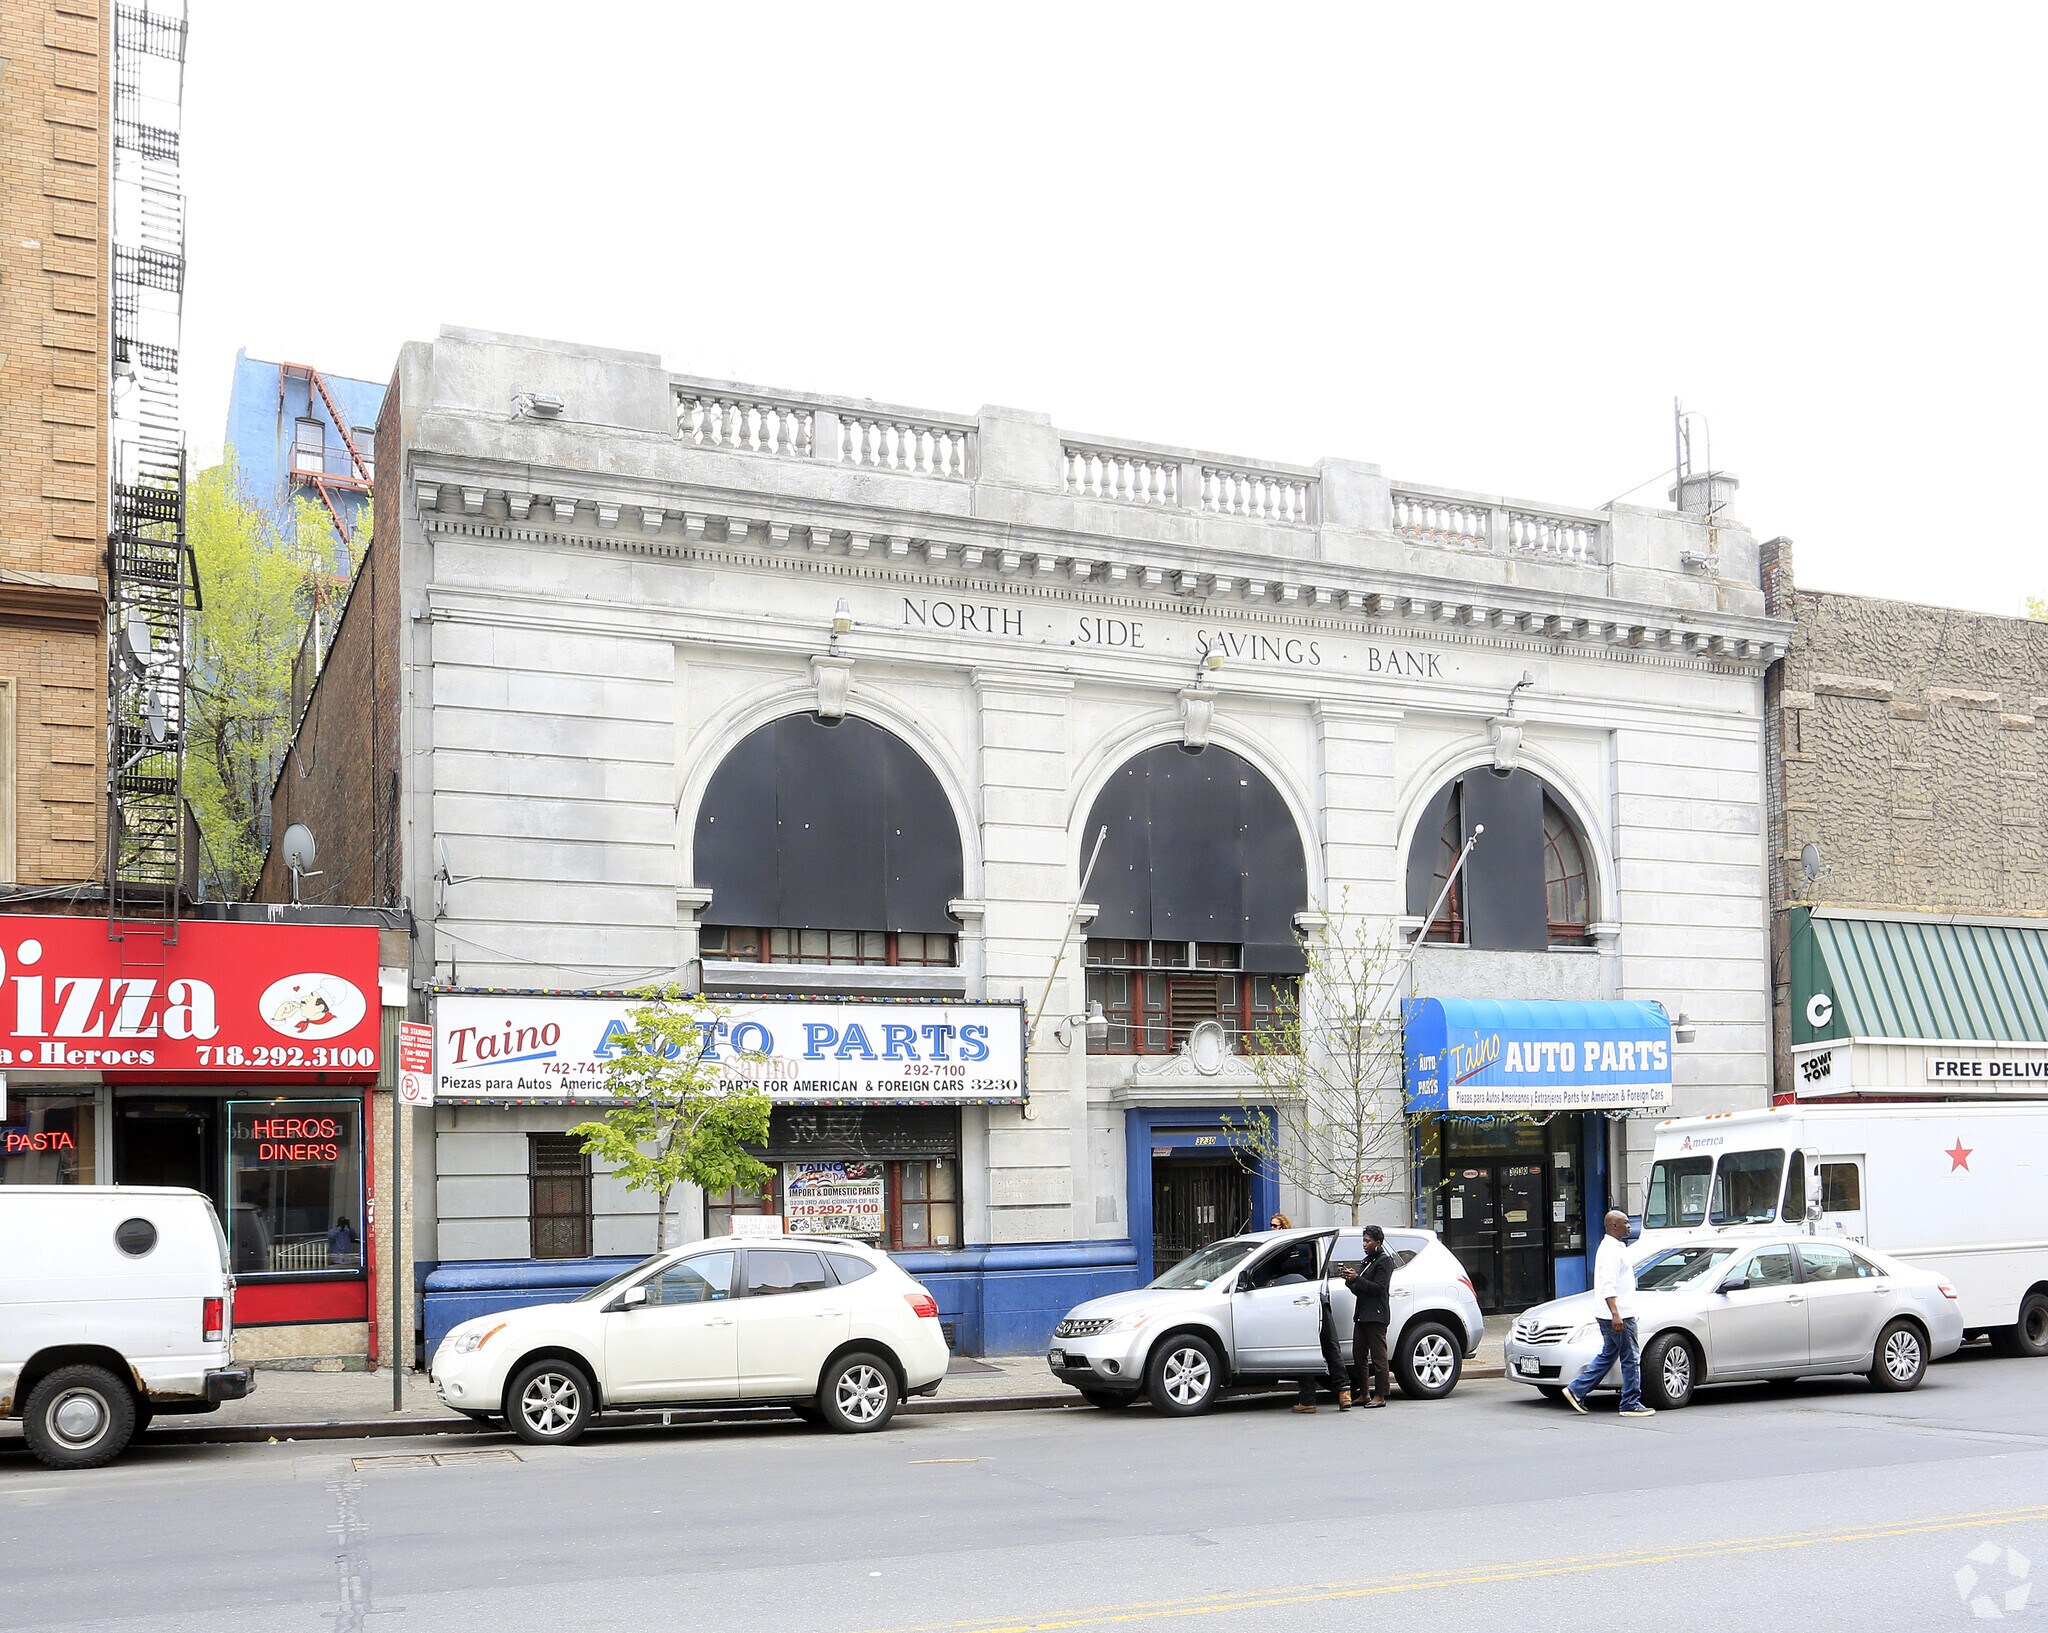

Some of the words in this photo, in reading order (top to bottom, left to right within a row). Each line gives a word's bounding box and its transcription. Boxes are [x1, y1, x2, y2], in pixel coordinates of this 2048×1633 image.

[902, 597, 1023, 636] NORTH
[1078, 616, 1145, 649] SIDE
[1195, 629, 1321, 666] SAVINGS
[1368, 647, 1444, 679] BANK
[0, 939, 219, 1041] izza
[1806, 993, 1833, 1028] C
[448, 1020, 561, 1064] Taino
[802, 1023, 990, 1061] PARTS
[38, 1041, 155, 1066] Heroes
[195, 1045, 375, 1067] 718.292.3100
[1450, 1030, 1500, 1078] Taino
[1504, 1041, 1575, 1073] AUTO
[1583, 1040, 1668, 1072] PARTS
[904, 1064, 966, 1077] 292-7100
[1419, 1056, 1436, 1071] AUTO
[1935, 1061, 1983, 1077] FREE
[441, 1076, 482, 1089] Piezas
[485, 1079, 514, 1092] para
[517, 1077, 552, 1090] Autos
[764, 1080, 788, 1092] FOR
[793, 1080, 858, 1092] AMERICAN
[865, 1080, 873, 1092] &
[878, 1081, 929, 1092] FOREIGN
[933, 1080, 964, 1091] CARS
[971, 1079, 1018, 1091] 3230
[1418, 1079, 1439, 1095] PARTS
[1456, 1091, 1473, 1104] Piezas
[1473, 1094, 1485, 1107] para
[1486, 1091, 1500, 1104] Autos
[1563, 1091, 1580, 1104] Parts
[1581, 1091, 1590, 1103] for
[1591, 1090, 1620, 1103] American
[1620, 1089, 1626, 1101] &
[1627, 1089, 1649, 1104] Foreign
[1650, 1088, 1664, 1101] Cars
[254, 1118, 336, 1139] HEROS
[7, 1131, 74, 1152] PASTA
[1197, 1137, 1216, 1145] 3230
[1680, 1136, 1724, 1151] America
[259, 1143, 338, 1161] DINER'S
[795, 1162, 844, 1172] TAINO
[789, 1188, 815, 1197] IMPORT
[816, 1188, 822, 1196] &
[823, 1187, 858, 1197] DOMESTIC
[858, 1187, 880, 1196] PARTS
[790, 1204, 879, 1216] 718-292-7100
